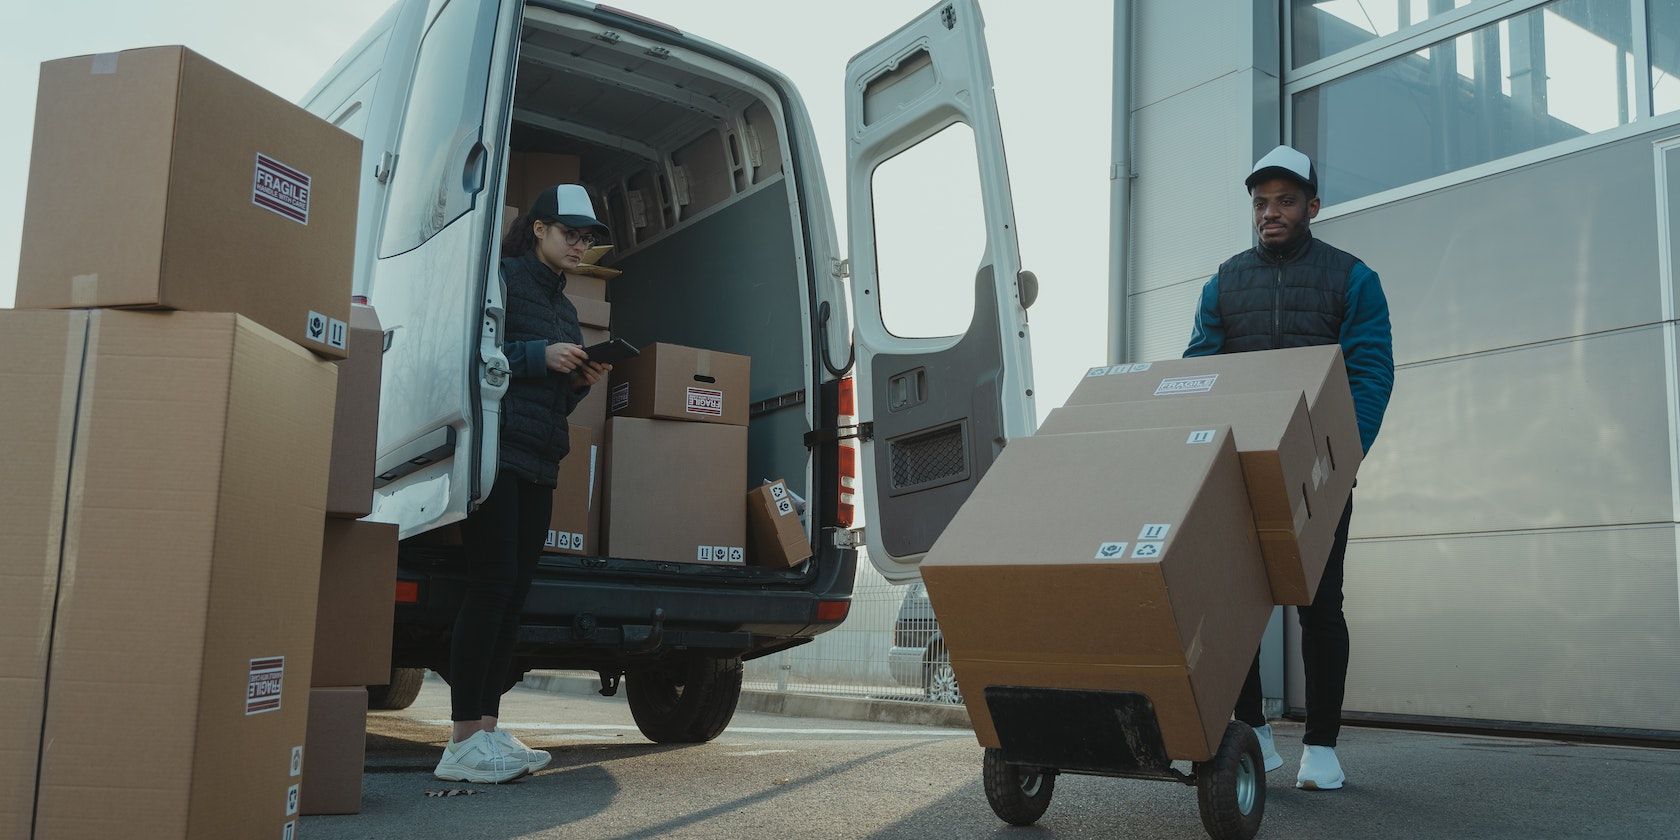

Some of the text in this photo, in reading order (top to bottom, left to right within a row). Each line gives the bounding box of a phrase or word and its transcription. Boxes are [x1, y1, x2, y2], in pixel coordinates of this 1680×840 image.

[257, 169, 307, 202] FRAGILE
[256, 184, 306, 210] HANDLE WITH CARE
[689, 398, 720, 408] FRAGILE
[249, 680, 280, 697] FRAGILE
